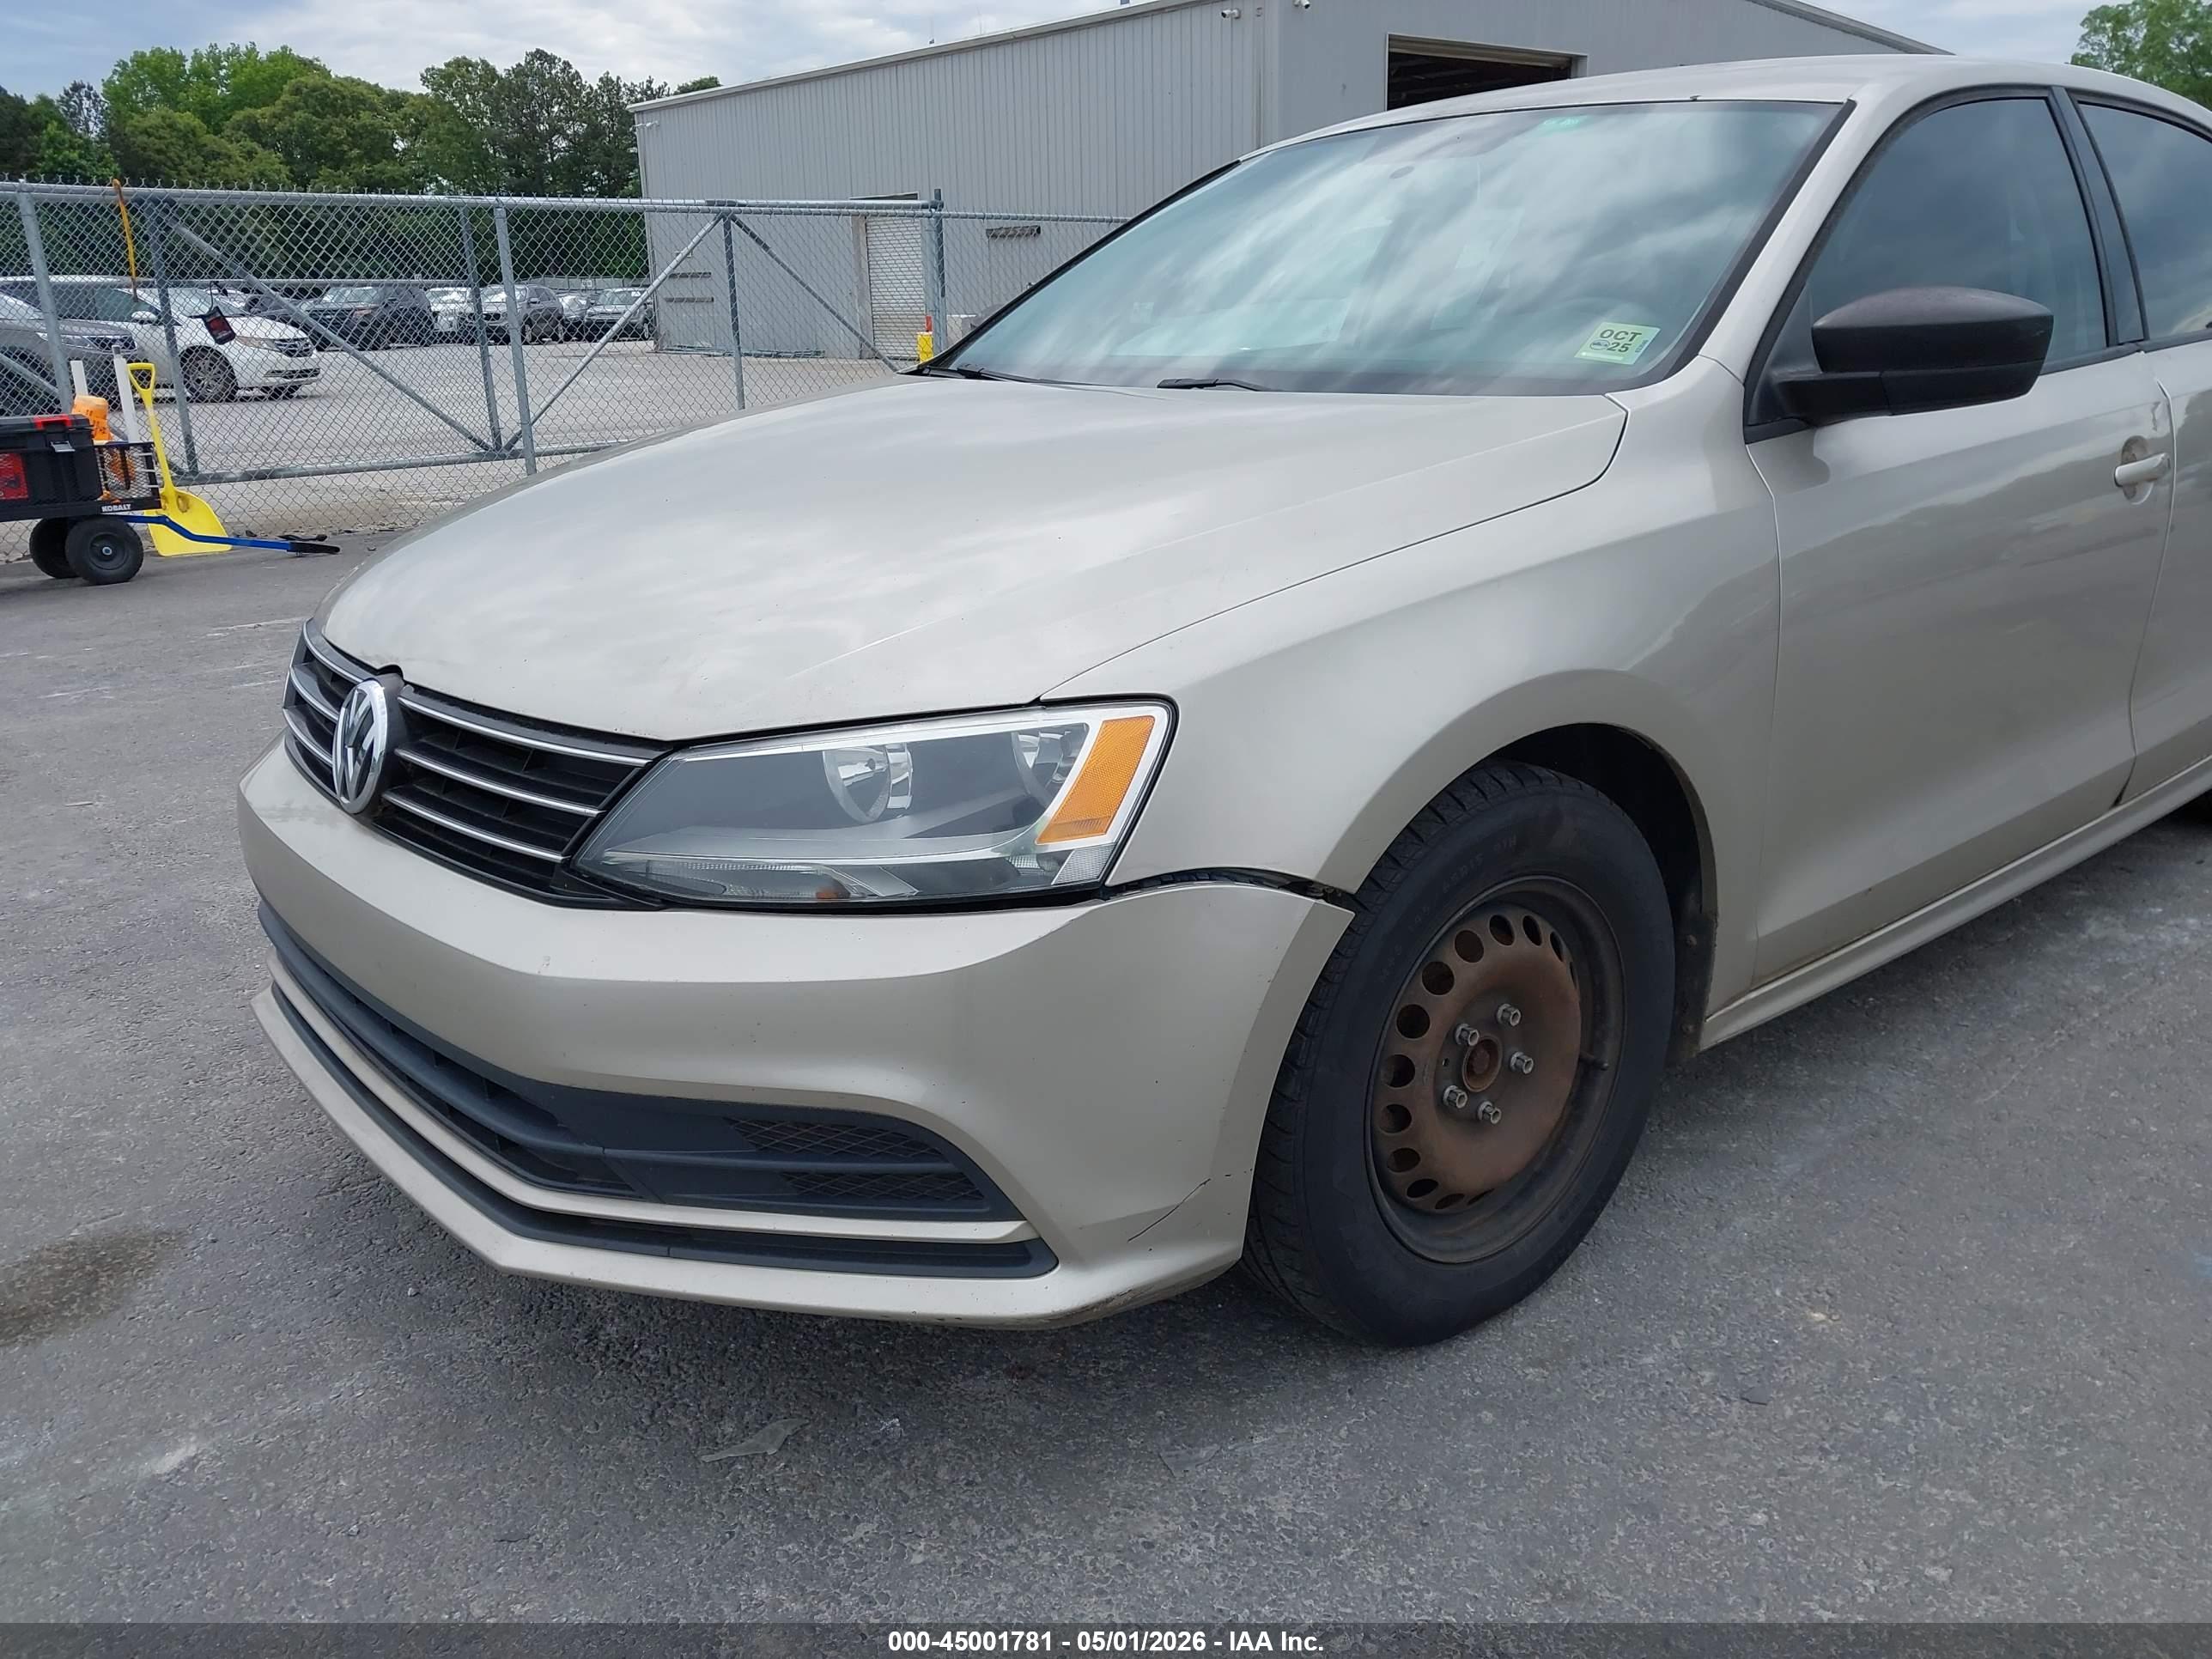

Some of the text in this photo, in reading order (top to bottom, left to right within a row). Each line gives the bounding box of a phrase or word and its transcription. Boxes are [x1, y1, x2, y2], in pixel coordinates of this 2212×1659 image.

[1600, 329, 1642, 342] OCT
[1607, 342, 1632, 353] 25
[101, 503, 131, 512] KOBALT
